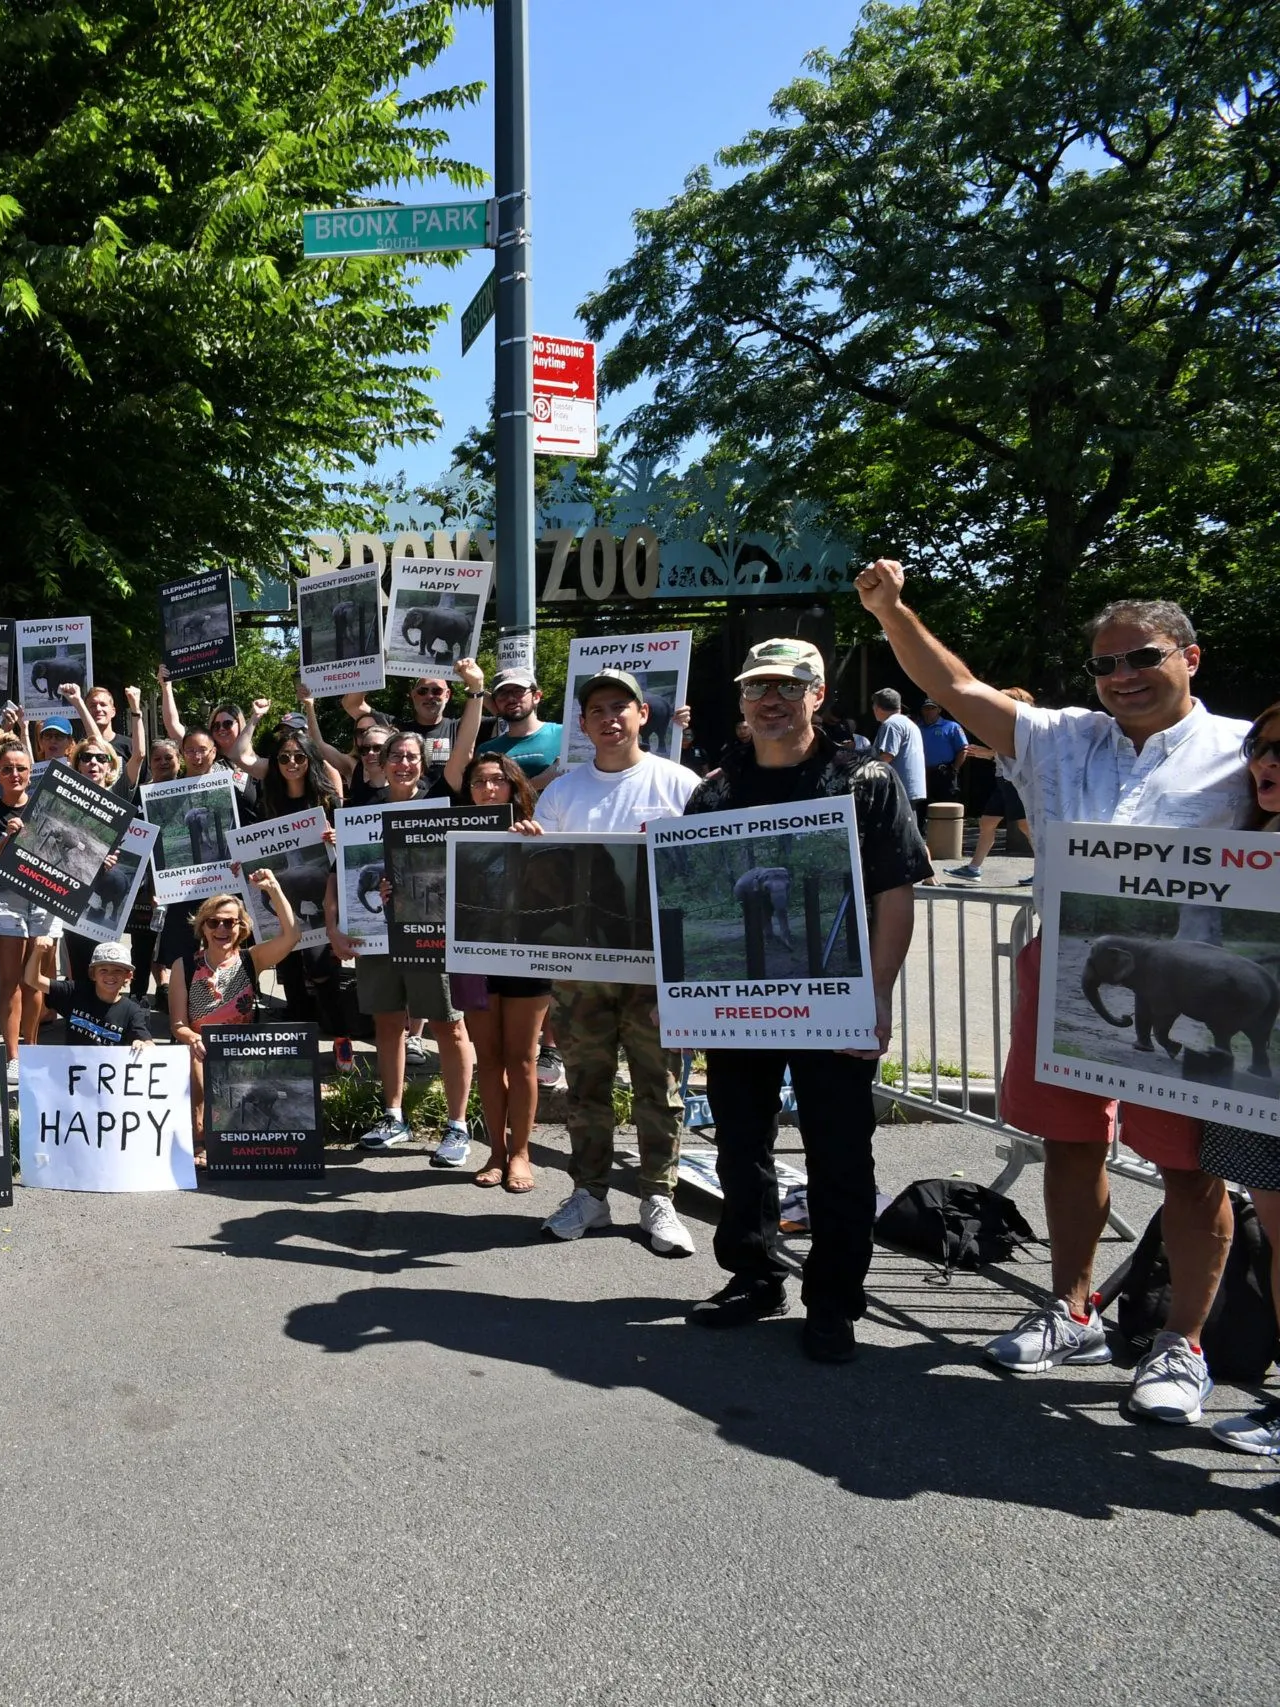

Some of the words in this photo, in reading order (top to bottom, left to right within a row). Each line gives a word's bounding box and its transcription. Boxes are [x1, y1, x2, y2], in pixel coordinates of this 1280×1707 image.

[315, 211, 398, 239] BRONX
[412, 207, 478, 233] PARK
[376, 237, 419, 250] SOUTH
[533, 341, 544, 351] NO
[546, 342, 584, 358] STANDING
[534, 355, 566, 369] Anytime
[402, 565, 442, 577] HAPPY
[444, 567, 455, 576] IS
[457, 568, 483, 578] NOT
[540, 527, 659, 601] ZOO
[300, 578, 337, 593] INNOCENT
[338, 570, 376, 586] PRISONER
[420, 580, 460, 592] HAPPY
[38, 636, 69, 645] HAPPY
[503, 643, 515, 651] NO
[580, 644, 628, 656] HAPPY
[631, 643, 645, 652] IS
[647, 640, 680, 651] NOT
[305, 663, 331, 674] GRANT
[331, 659, 357, 671] HAPPY
[358, 657, 376, 667] HER
[323, 670, 361, 682] FREEDOM
[52, 768, 101, 802] ELEPHANTS
[100, 795, 127, 817] DON'T
[145, 785, 187, 799] INNOCENT
[188, 778, 229, 792] PRISONER
[55, 785, 90, 810] BELONG
[90, 805, 114, 824] HERE
[391, 817, 459, 830] ELEPHANTS
[462, 815, 499, 825] DON'T
[654, 823, 746, 845] INNOCENT
[748, 811, 845, 835] PRISONER
[235, 828, 276, 847] HAPPY
[278, 824, 291, 835] IS
[291, 816, 317, 831] NOT
[259, 838, 300, 856] HAPPY
[1068, 838, 1174, 863] HAPPY
[1182, 846, 1212, 866] IS
[15, 849, 40, 867] SEND
[39, 861, 71, 884] HAPPY
[68, 877, 81, 890] TO
[17, 864, 70, 897] SANCTUARY
[180, 875, 222, 887] FREEDOM
[1119, 875, 1231, 902] HAPPY
[403, 924, 435, 933] SEND
[453, 946, 507, 956] WELCOME
[510, 949, 524, 959] TO
[526, 950, 549, 960] THE
[551, 951, 592, 963] BRONX
[594, 953, 655, 965] ELEPHANT
[530, 962, 573, 974] PRISON
[668, 983, 733, 1000] GRANT
[736, 982, 806, 998] HAPPY
[808, 981, 851, 996] HER
[714, 1005, 811, 1021] FREEDOM
[105, 1022, 124, 1033] FOR
[666, 1028, 736, 1038] NONHUMAN
[745, 1028, 796, 1038] RIGHTS
[806, 1028, 871, 1038] PROJECT
[209, 1032, 272, 1042] ELEPHANTS
[274, 1031, 308, 1041] DON'T
[223, 1047, 267, 1057] BELONG
[269, 1046, 298, 1056] HERE
[68, 1062, 168, 1099] FREE
[40, 1108, 171, 1157] HAPPY
[220, 1132, 250, 1142] SEND
[252, 1131, 290, 1142] HAPPY
[291, 1131, 306, 1141] TO
[231, 1146, 298, 1156] SANCTUARY
